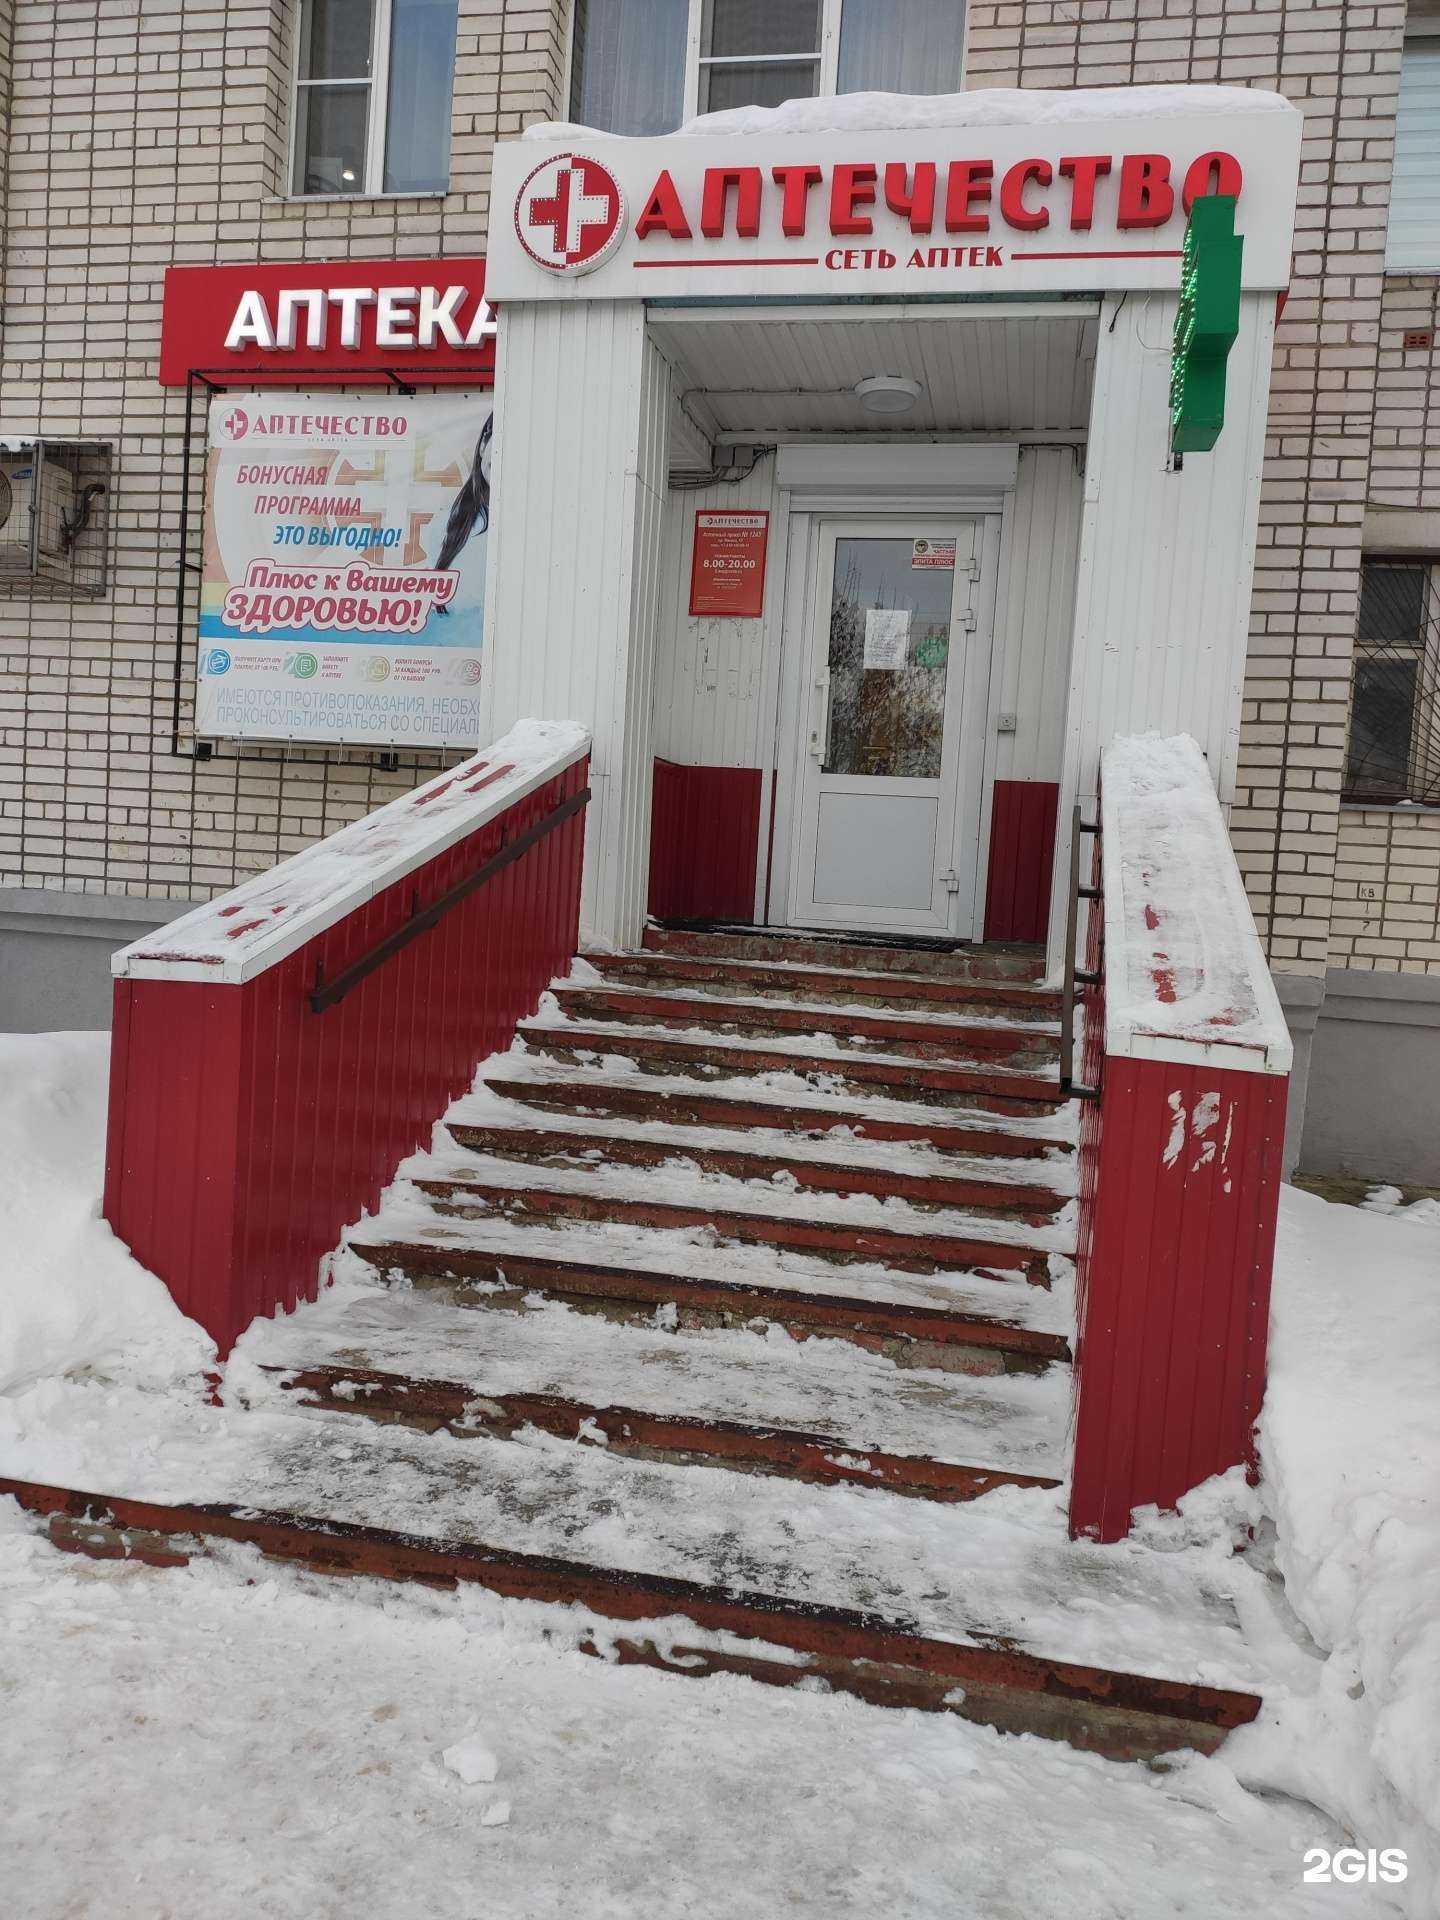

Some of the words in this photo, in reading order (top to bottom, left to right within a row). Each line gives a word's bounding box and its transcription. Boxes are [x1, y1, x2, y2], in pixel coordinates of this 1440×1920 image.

[635, 151, 1243, 240] АПТЕЧЕСТВО
[825, 249, 897, 271] СЕТЬ
[906, 246, 1004, 268] АПТЕК
[252, 415, 408, 436] АПТЕЧЕСТВО
[236, 465, 331, 486] БОНУСНАЯ
[254, 495, 362, 517] ПРОГРАММА
[273, 525, 304, 546] ЭТО
[307, 526, 403, 550] ВЫГОДНО!
[703, 559, 756, 569] 8.00-20.00
[249, 566, 318, 591] Плюс
[324, 572, 341, 591] к
[346, 569, 454, 599] Вашему
[227, 593, 423, 627] ЗДОРОВЬЮ!
[216, 687, 282, 706] ИМЕЮТСЯ
[432, 697, 480, 716] НЕОБХ
[216, 706, 387, 731] ПРОКОНСУЛЬТИРОВАТЬСЯ
[390, 714, 410, 731] СО
[413, 715, 480, 736] СПЕЦИАЛ
